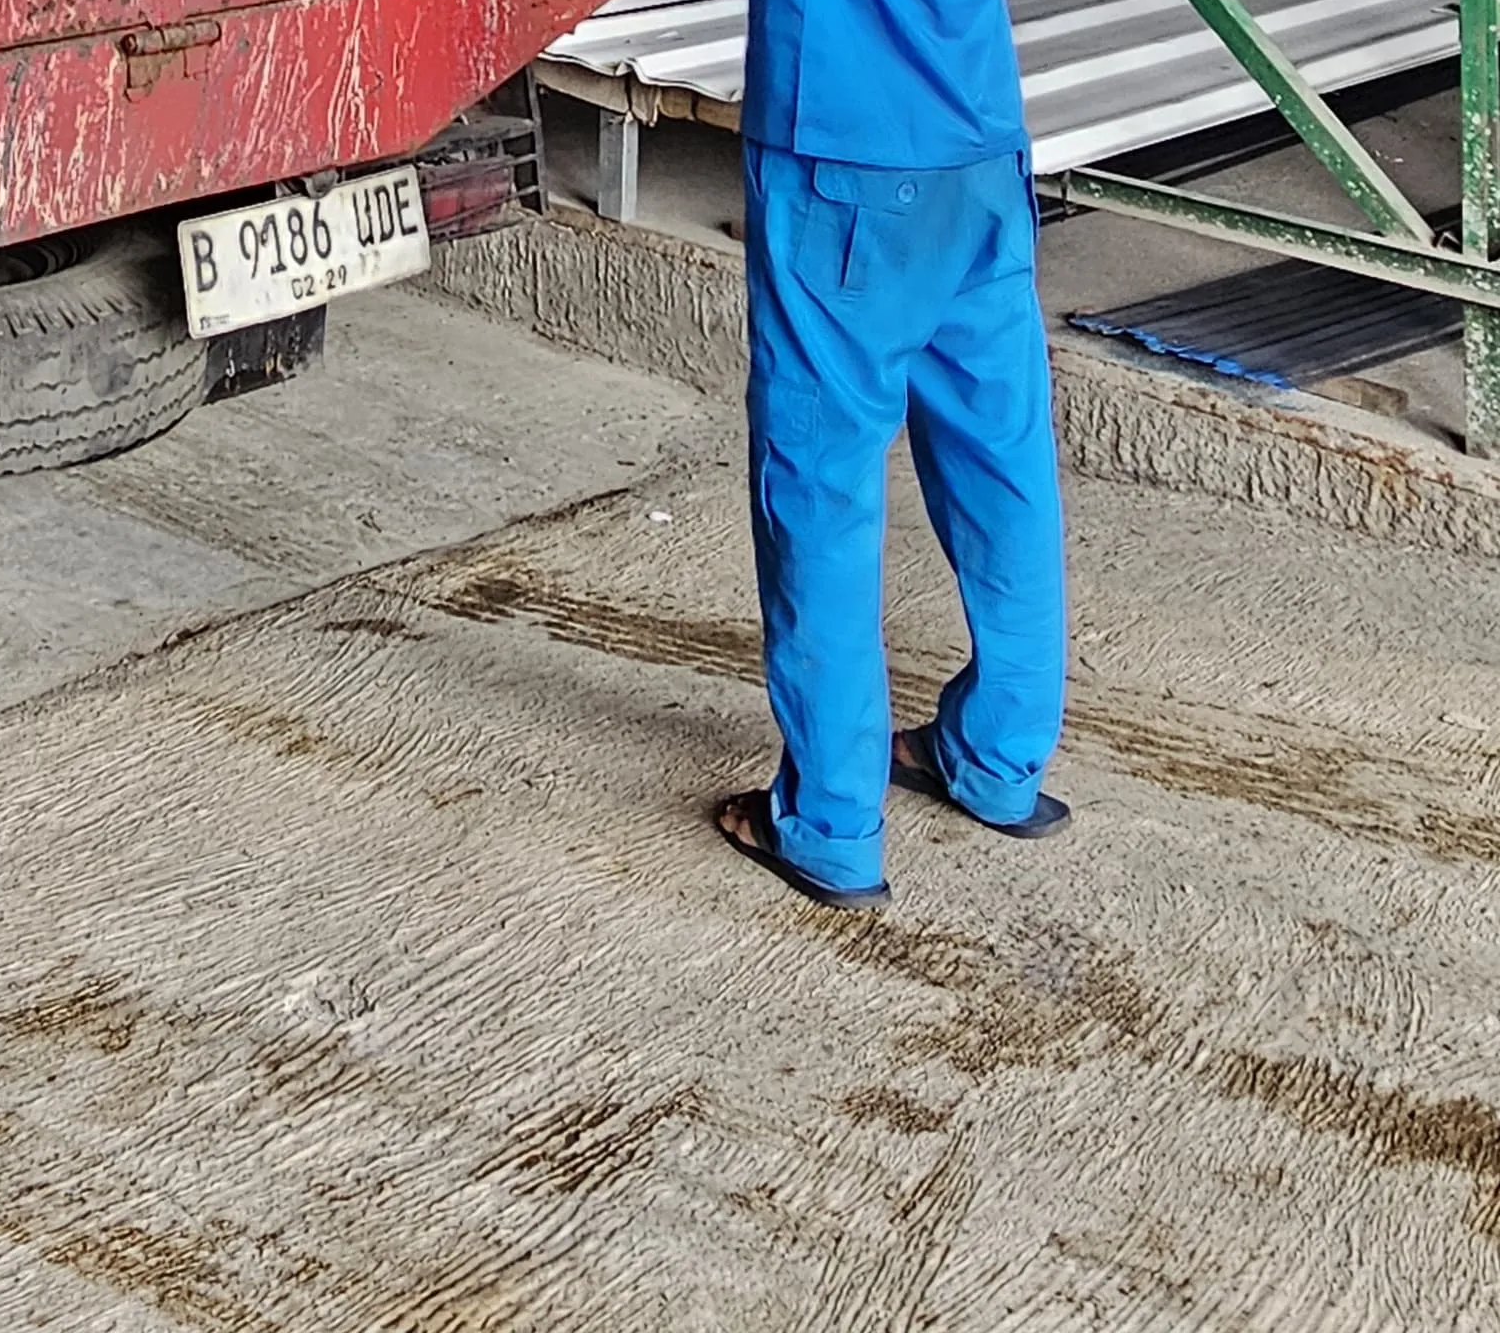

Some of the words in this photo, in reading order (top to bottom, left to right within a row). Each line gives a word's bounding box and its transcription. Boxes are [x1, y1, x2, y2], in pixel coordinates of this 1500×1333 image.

[192, 230, 218, 293] B
[239, 201, 333, 280] 9186
[351, 178, 419, 249] UDE
